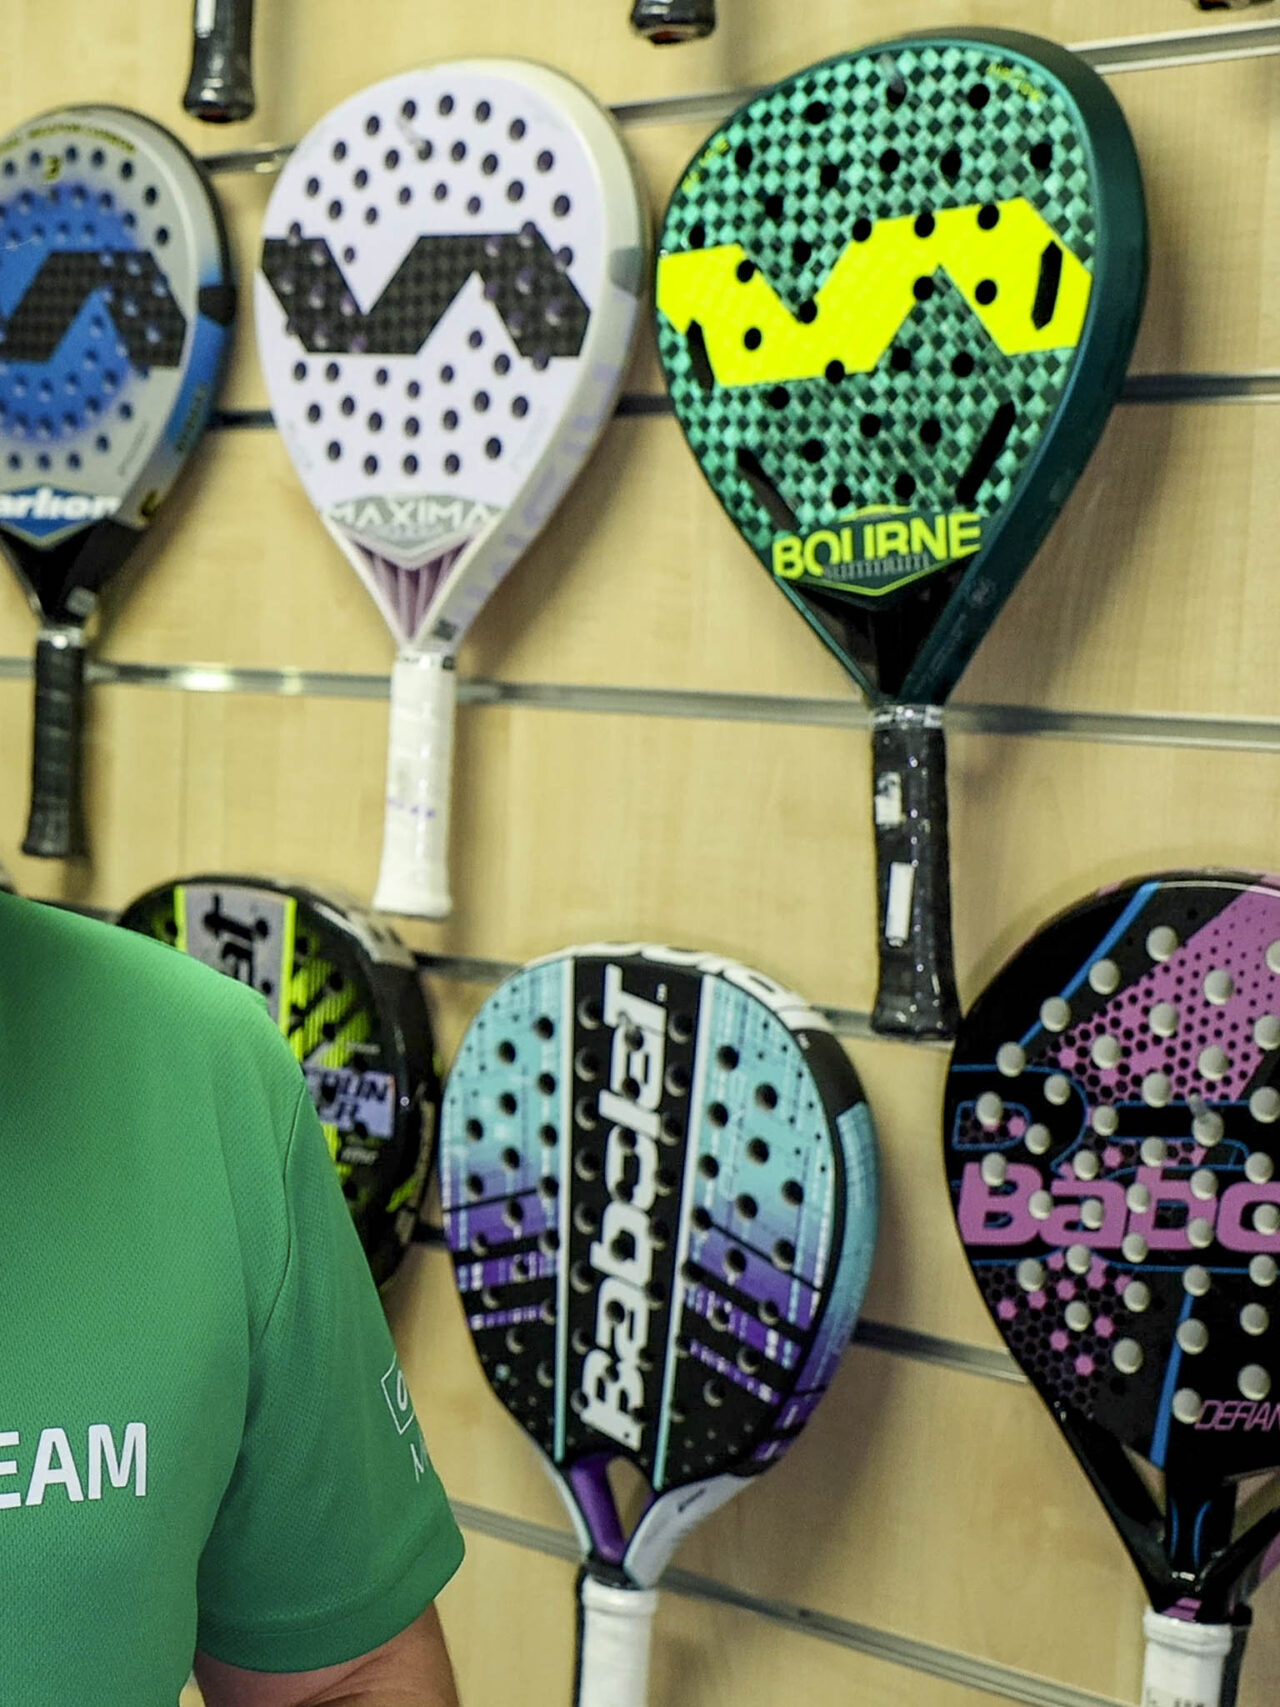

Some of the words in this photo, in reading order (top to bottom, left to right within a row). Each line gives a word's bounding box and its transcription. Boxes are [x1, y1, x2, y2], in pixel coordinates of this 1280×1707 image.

[325, 494, 506, 530] MAXIMA
[772, 511, 982, 580] BOURNE
[579, 962, 668, 1452] Babolat
